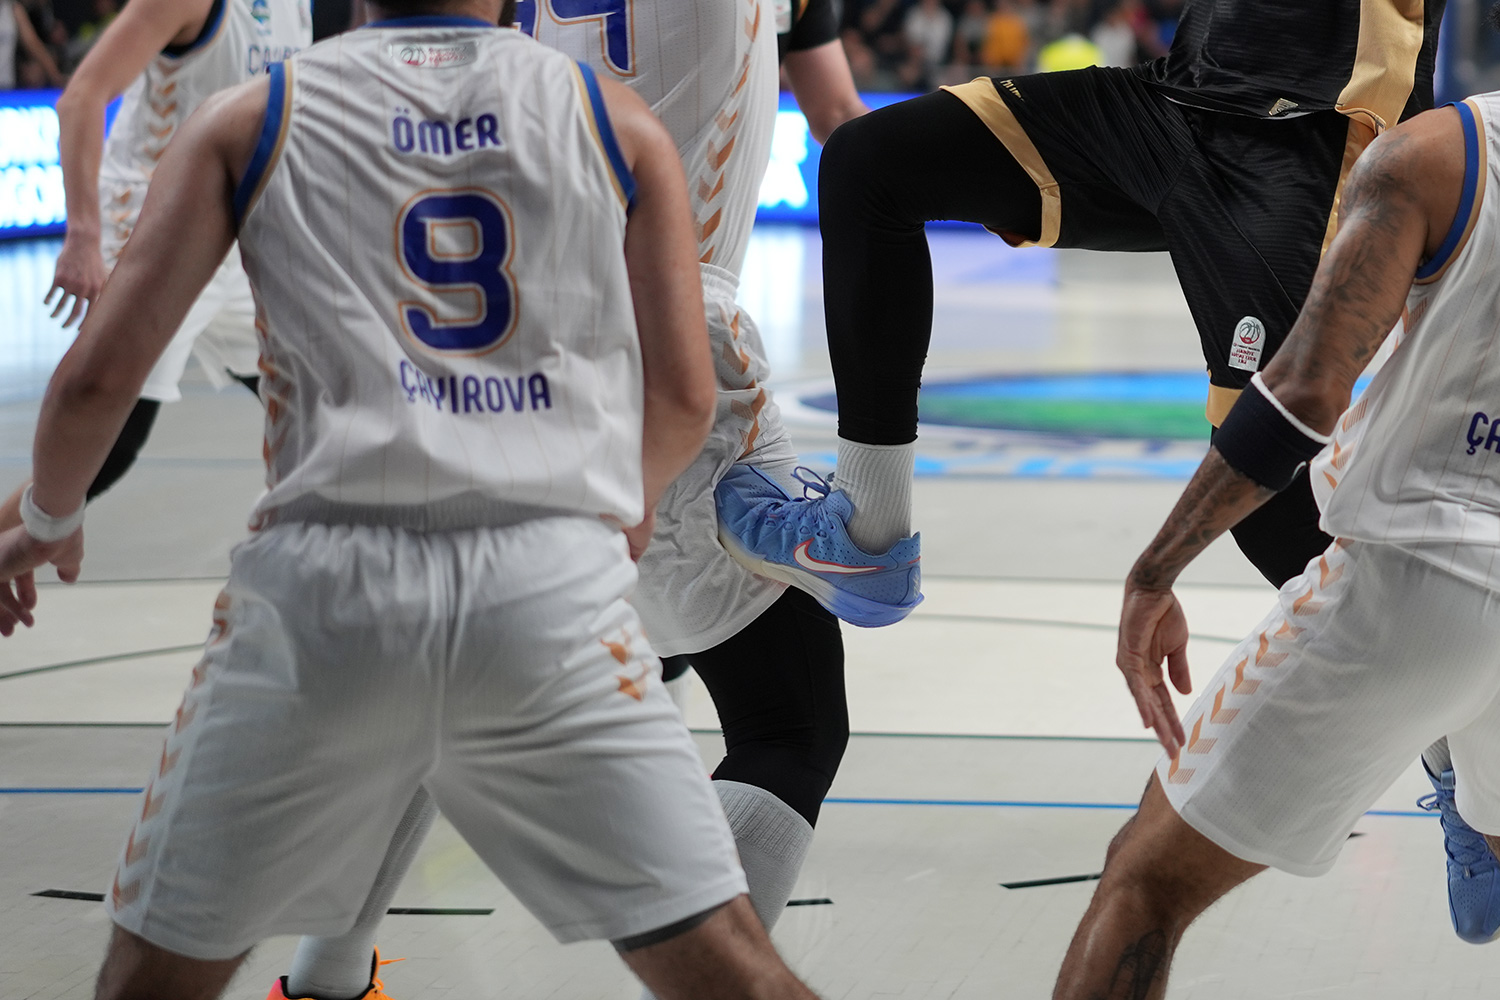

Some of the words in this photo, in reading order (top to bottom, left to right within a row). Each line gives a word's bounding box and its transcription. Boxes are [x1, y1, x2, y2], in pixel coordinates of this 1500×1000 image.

[391, 106, 502, 155] ÖMER
[395, 185, 520, 359] 9
[399, 358, 553, 414] ÇAYIROVA
